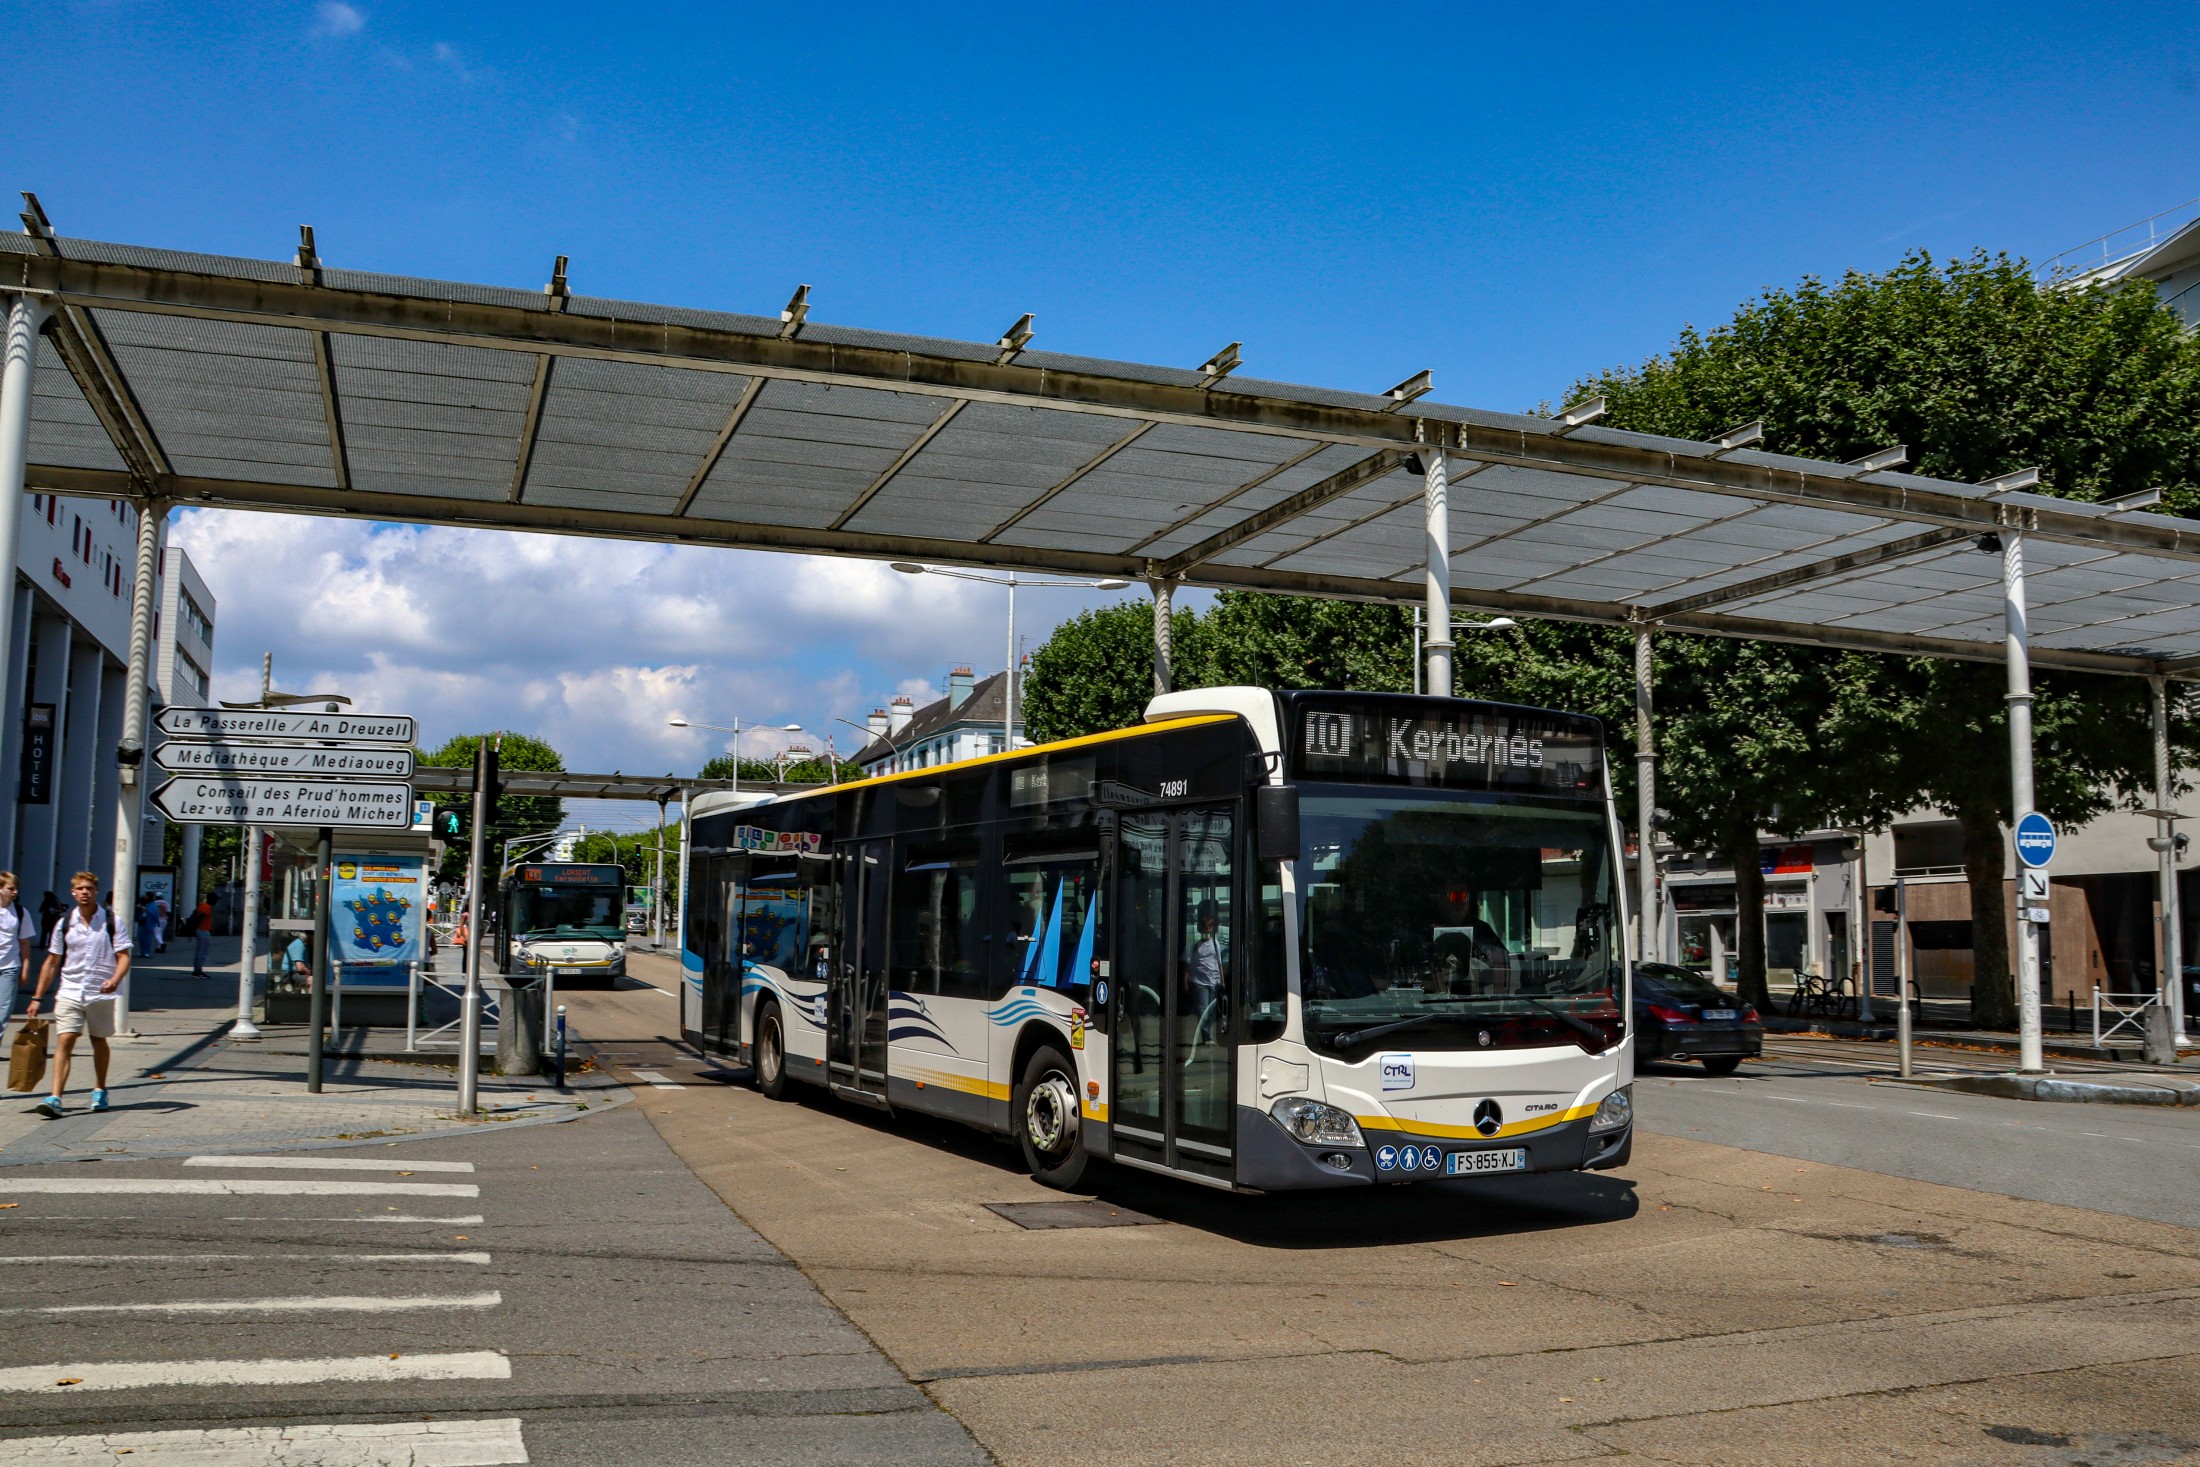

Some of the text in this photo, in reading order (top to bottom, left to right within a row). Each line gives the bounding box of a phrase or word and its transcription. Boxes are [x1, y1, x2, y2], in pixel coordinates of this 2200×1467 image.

[174, 715, 191, 728] La
[200, 715, 286, 731] Passerelle
[309, 720, 329, 733] An
[338, 721, 407, 736] Dreuzell
[1306, 711, 1350, 756] 10
[31, 735, 43, 797] HOTEL
[177, 750, 288, 768] Médiathèque
[312, 755, 405, 773] Mediaoueg
[197, 785, 402, 803] Conseil des Prud'hommes
[1160, 779, 1188, 798] 74891
[180, 801, 248, 816] Lez-varn
[256, 806, 274, 817] an
[282, 804, 340, 818] Aferioù
[347, 806, 402, 820] Micher
[1384, 1065, 1411, 1077] CTRL
[1525, 1103, 1558, 1112] CITARO
